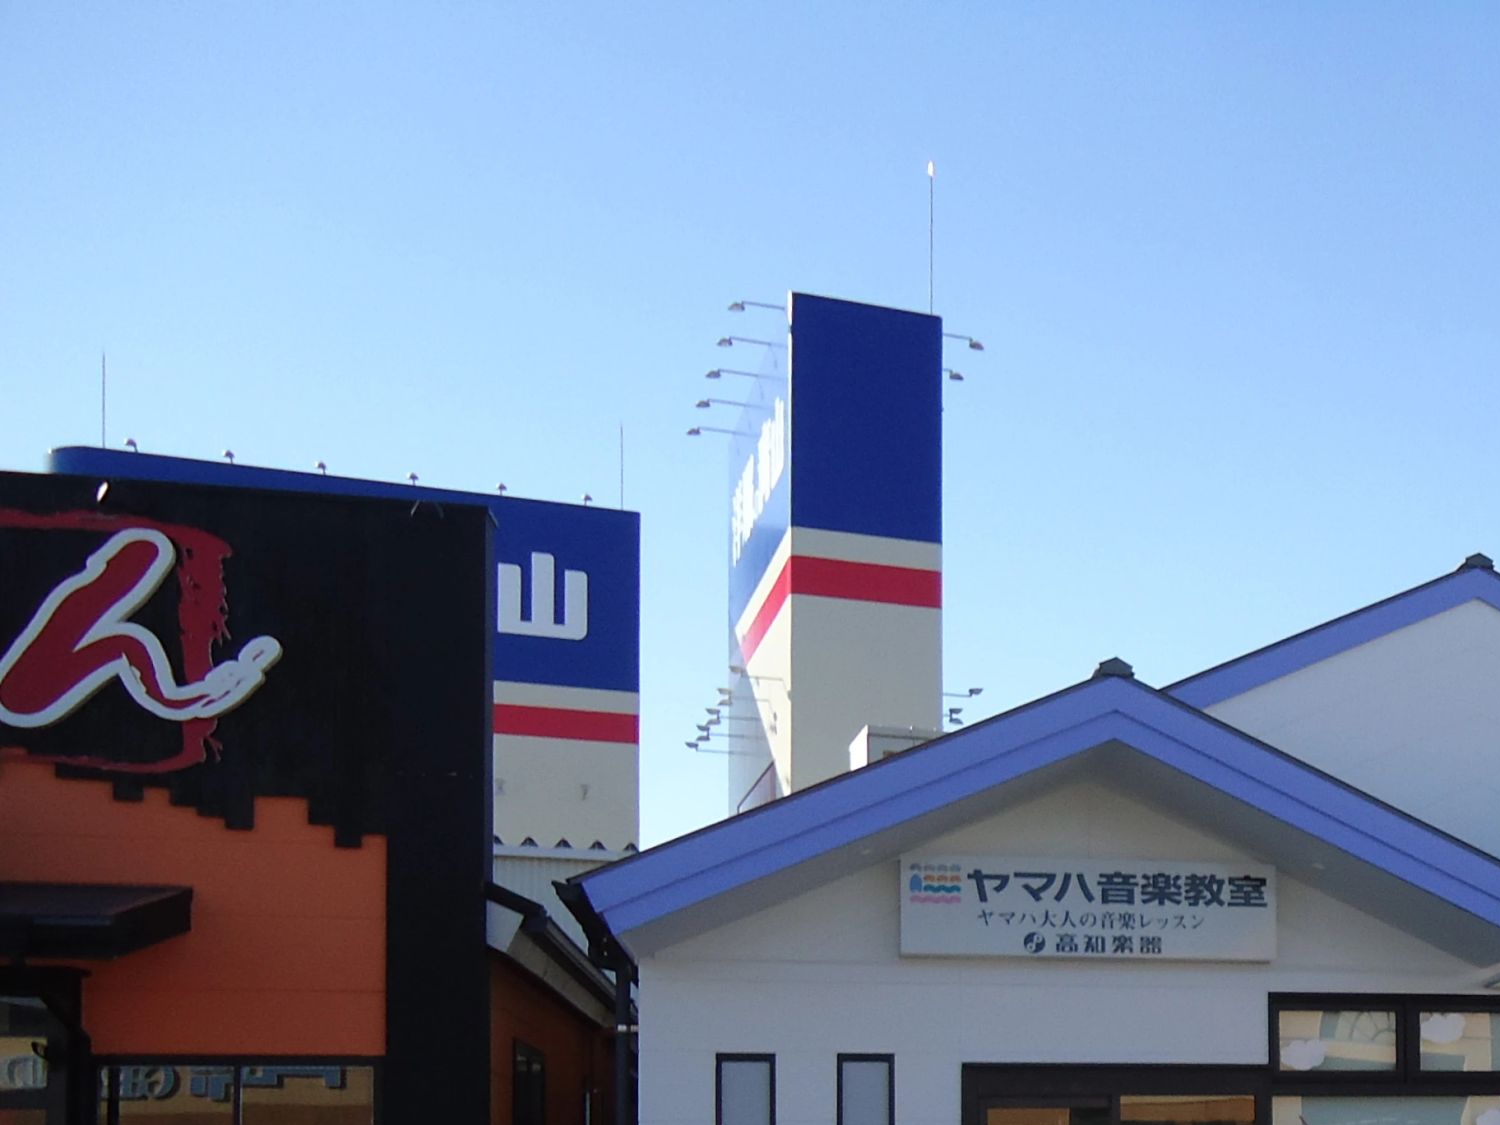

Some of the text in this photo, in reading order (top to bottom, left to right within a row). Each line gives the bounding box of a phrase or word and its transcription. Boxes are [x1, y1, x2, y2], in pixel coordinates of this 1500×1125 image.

[496, 551, 588, 641] 山
[967, 868, 1268, 908] ヤマハ音楽教室
[977, 909, 1206, 930] ヤマハ大人の音楽レッスン
[1055, 933, 1162, 954] 高知楽器
